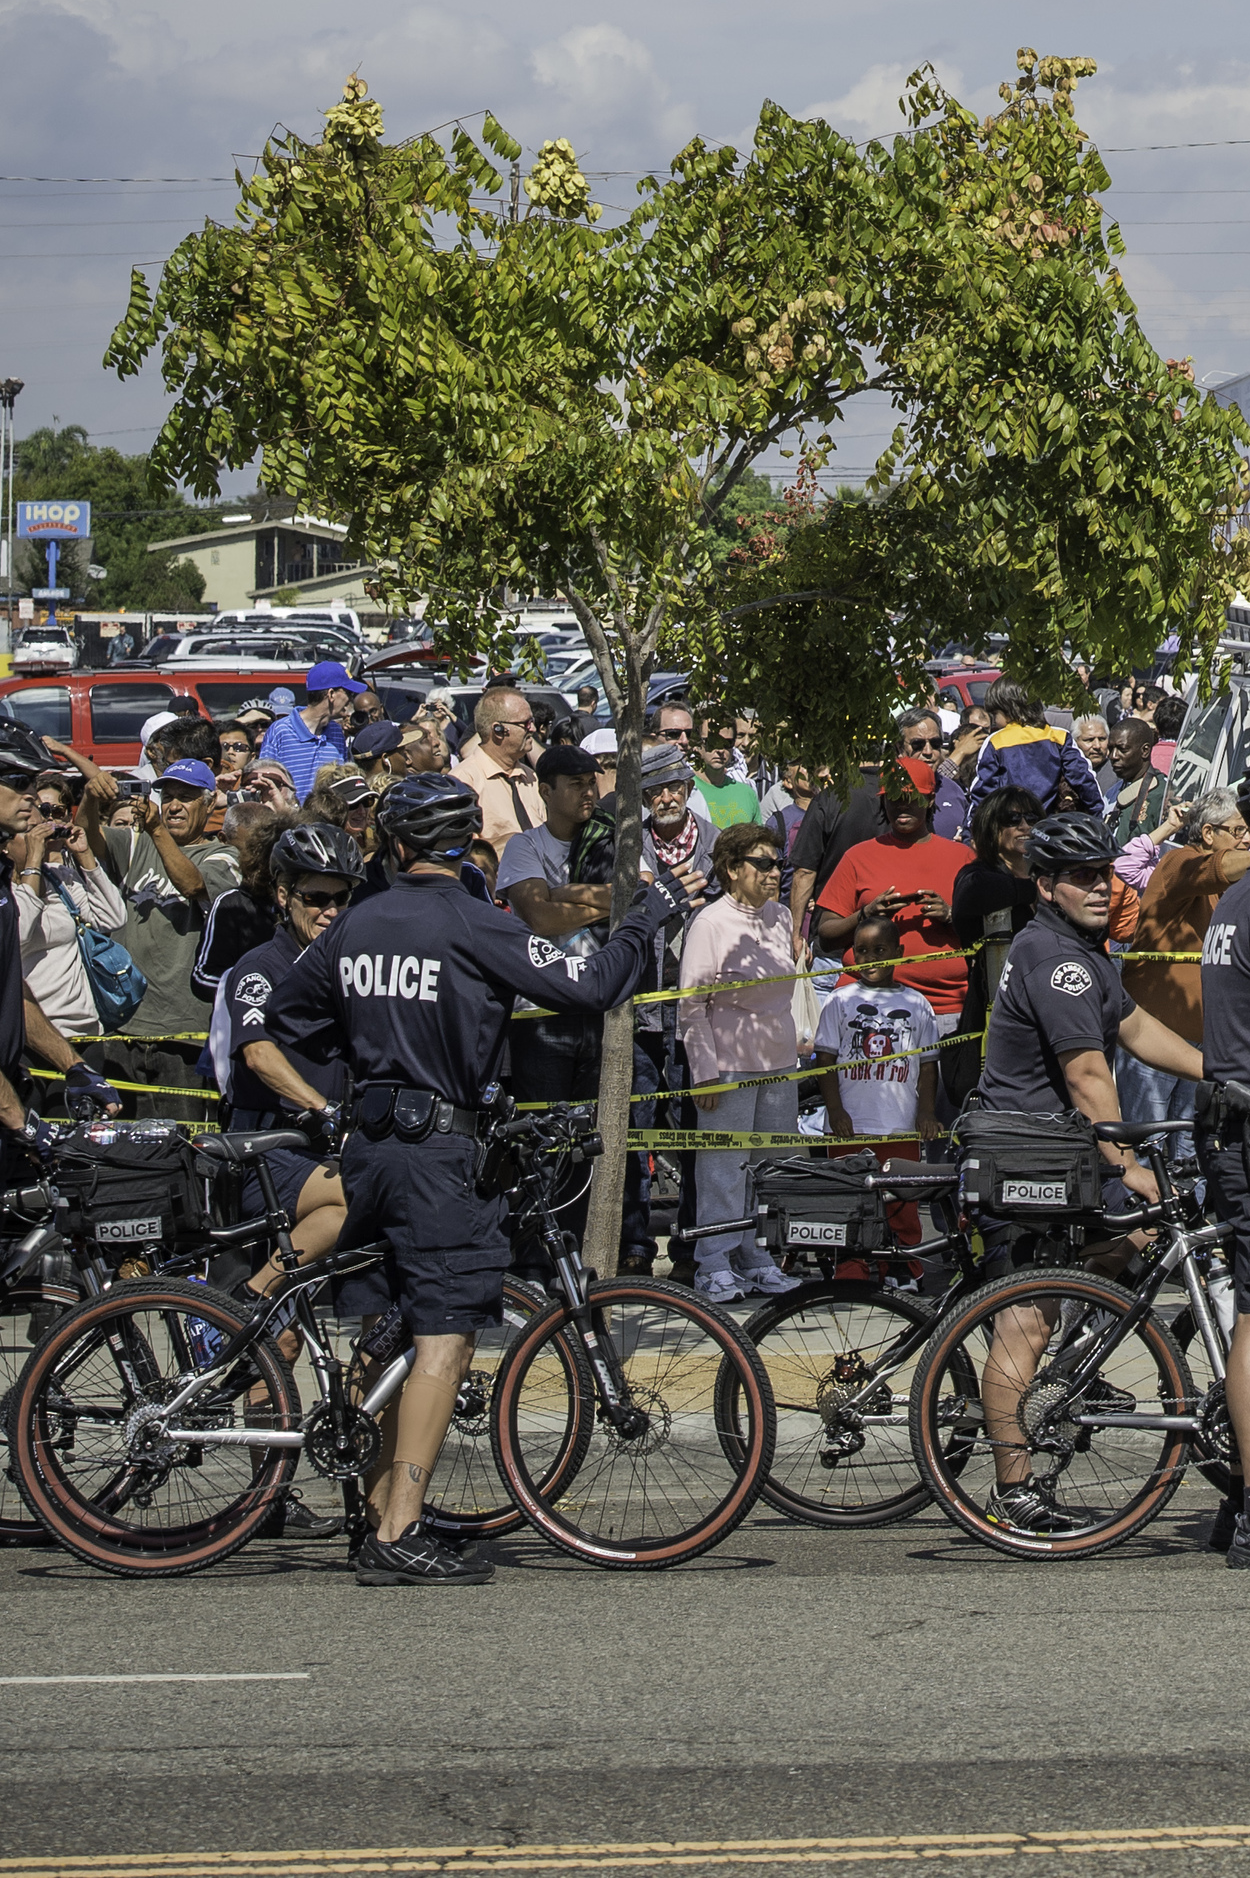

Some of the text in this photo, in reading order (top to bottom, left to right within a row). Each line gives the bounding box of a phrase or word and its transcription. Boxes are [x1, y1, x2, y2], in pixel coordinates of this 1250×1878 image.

[26, 504, 81, 524] IHOP
[338, 953, 442, 1003] POLICE
[1053, 969, 1064, 985] LOS
[1062, 981, 1087, 993] POLICE
[1007, 1184, 1064, 1199] POLICE
[99, 1222, 158, 1238] POLICE
[790, 1226, 843, 1241] POLICE
